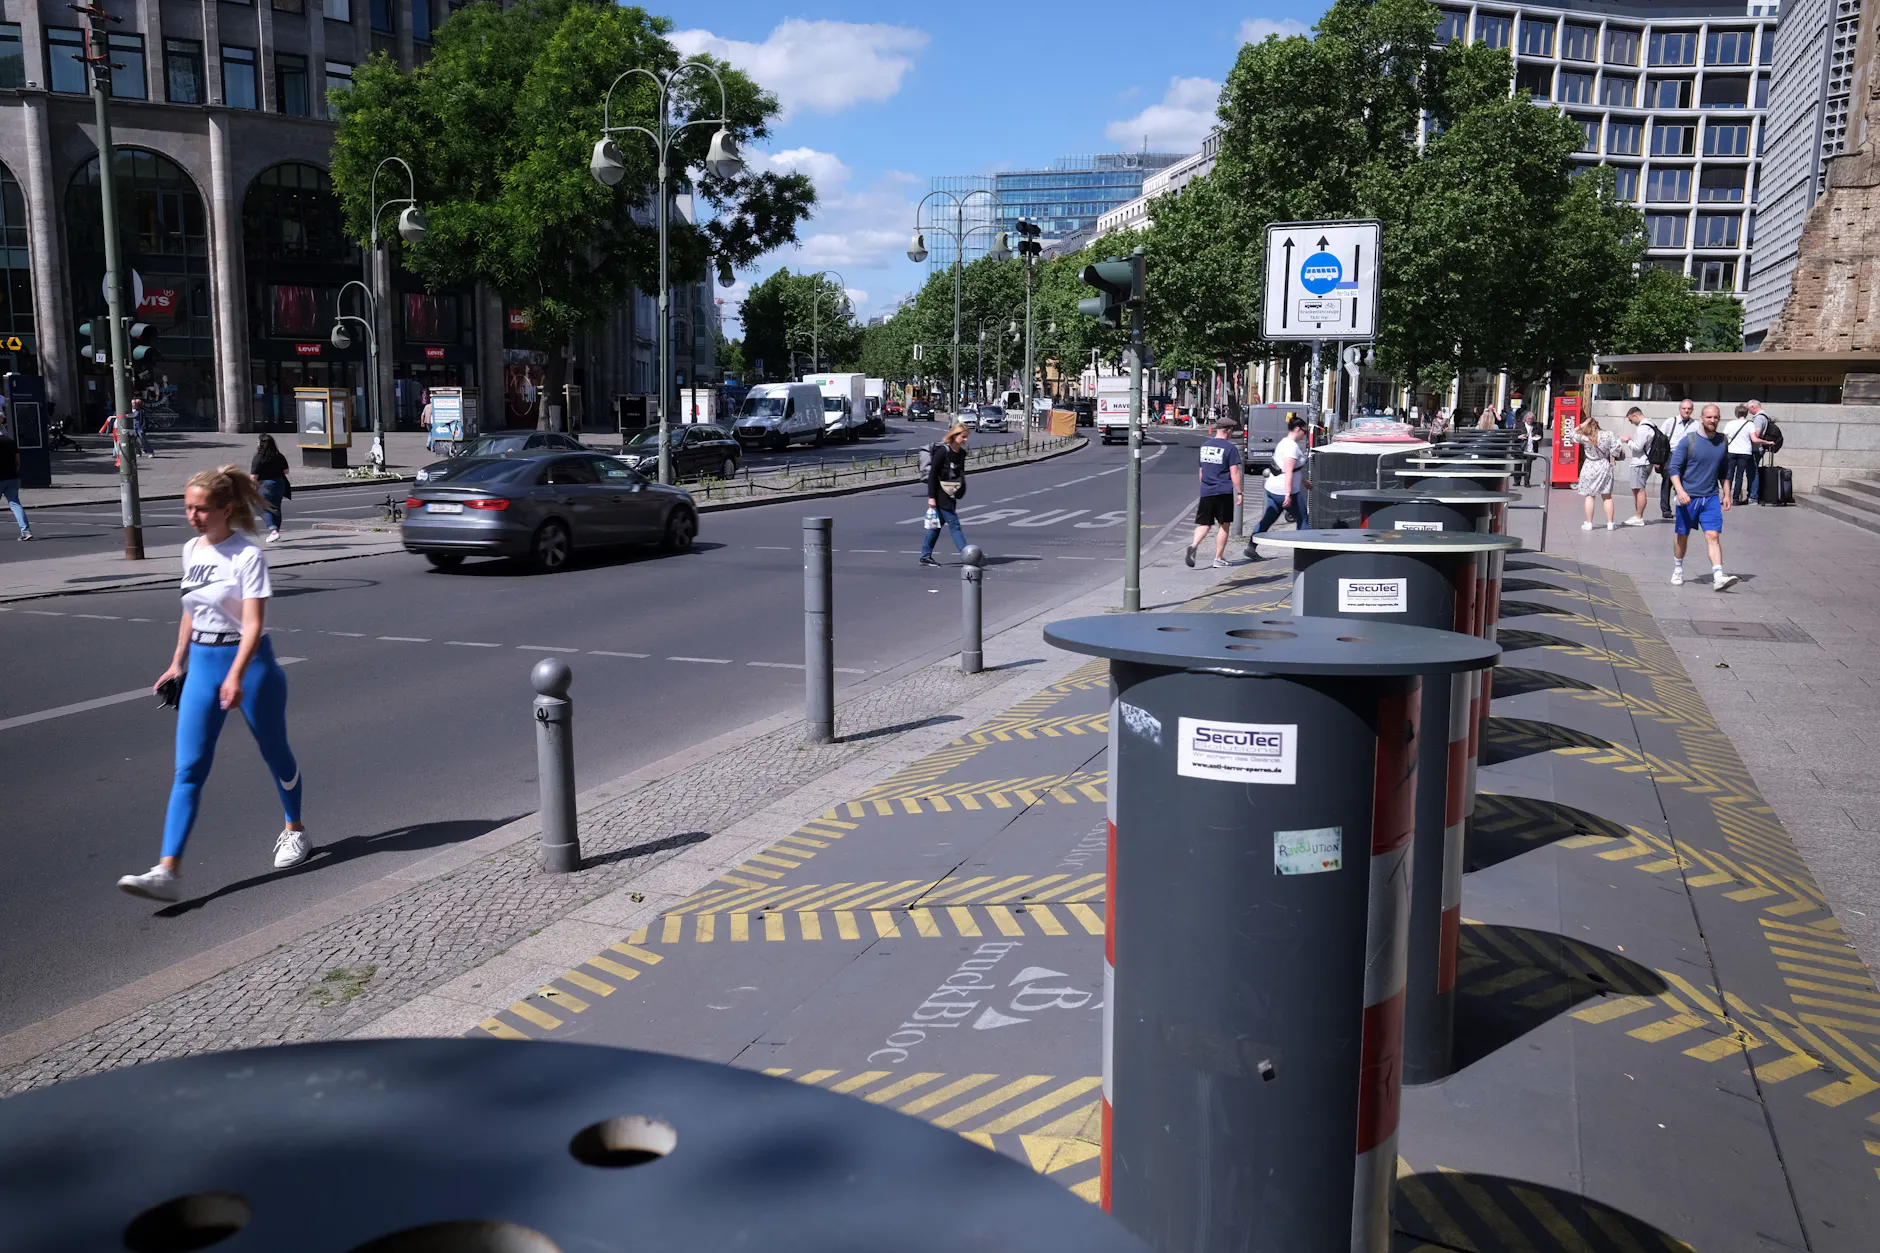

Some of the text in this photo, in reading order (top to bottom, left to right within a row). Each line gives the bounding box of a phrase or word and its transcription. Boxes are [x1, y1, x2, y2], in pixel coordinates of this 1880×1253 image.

[1807, 375, 1833, 383] SHOP
[946, 509, 1145, 529] BUS
[1349, 583, 1397, 592] SecuTec
[1195, 727, 1279, 747] SecuTec
[1195, 741, 1279, 753] Solutions
